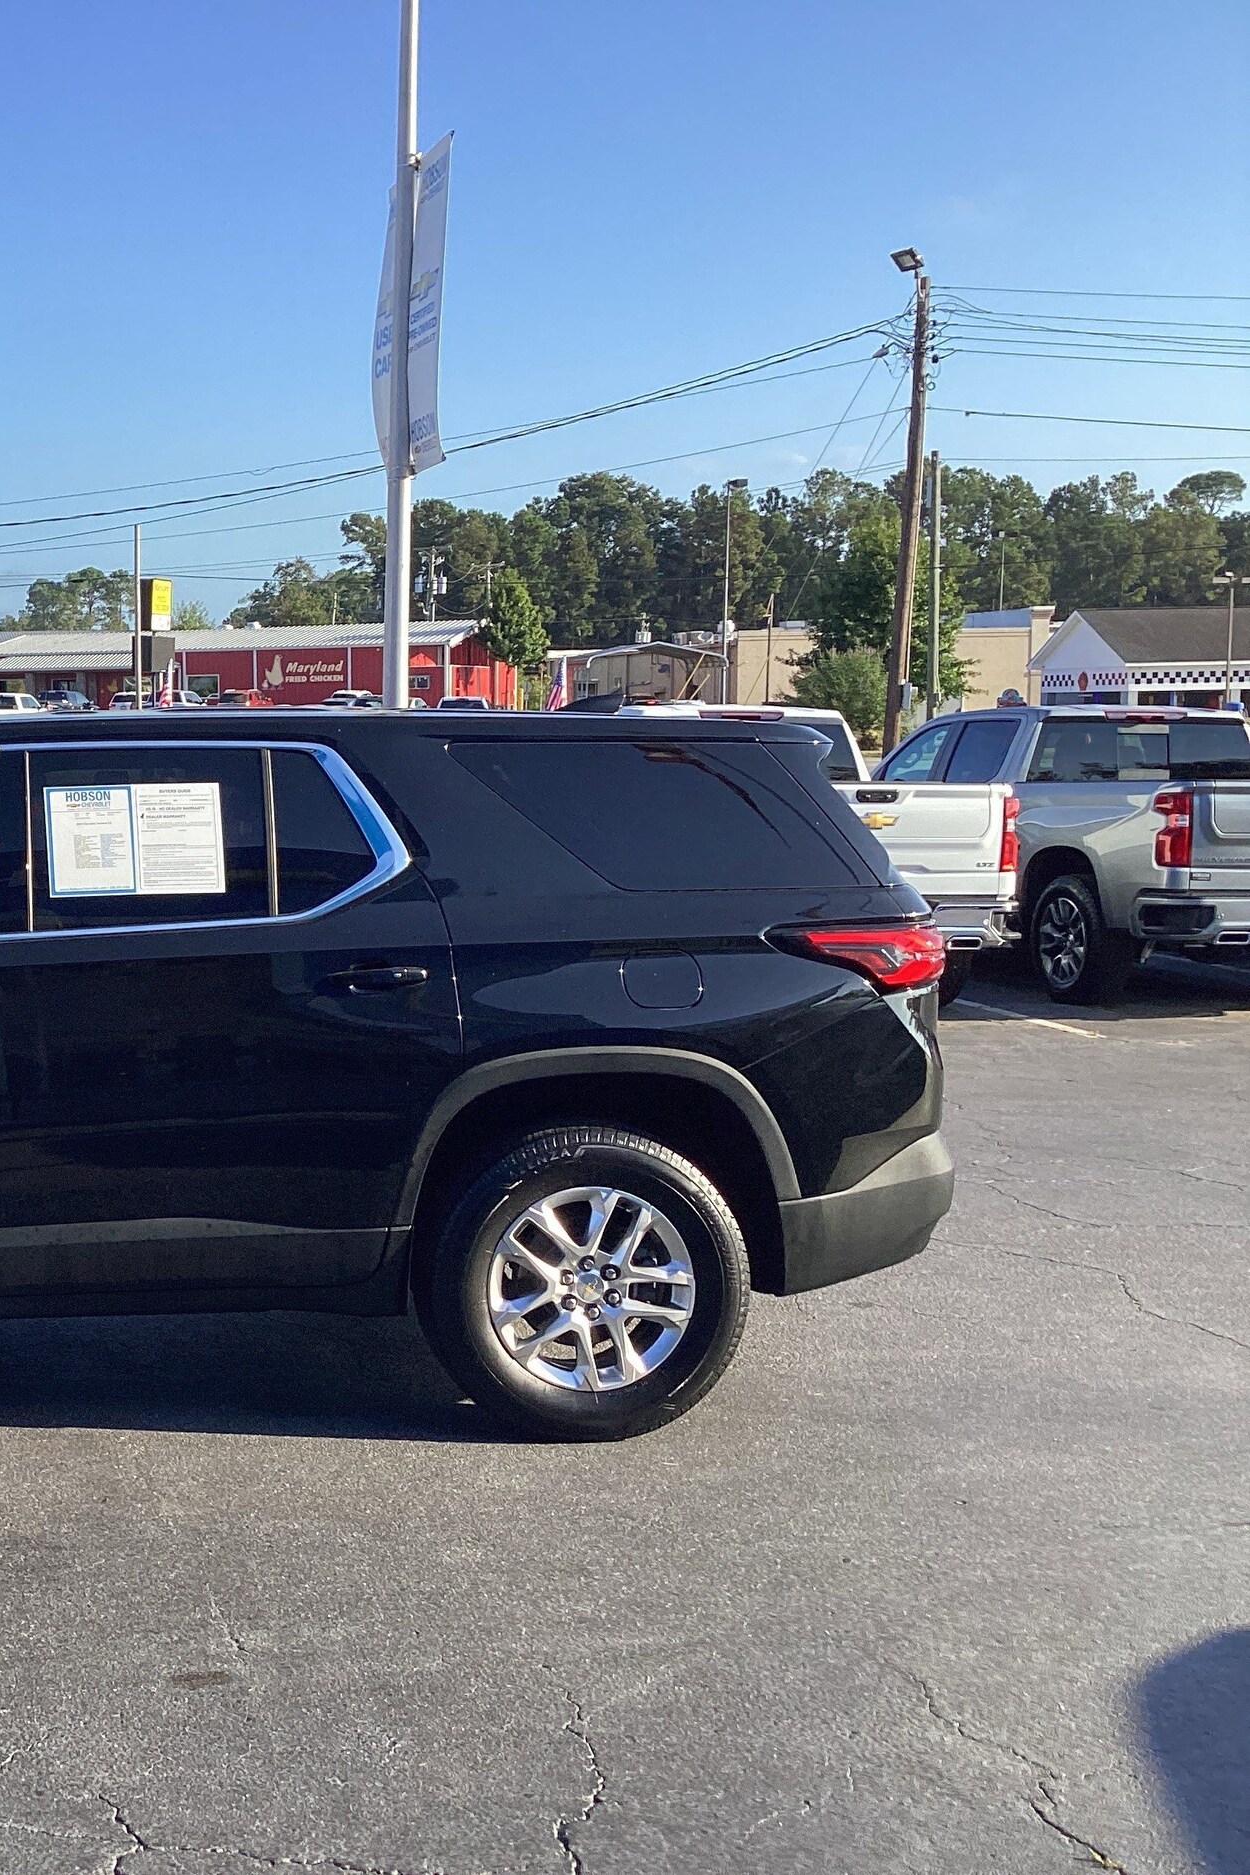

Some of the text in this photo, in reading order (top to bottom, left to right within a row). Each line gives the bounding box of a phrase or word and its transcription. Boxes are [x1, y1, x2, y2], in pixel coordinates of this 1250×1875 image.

[286, 660, 344, 675] Maryland
[285, 674, 344, 683] FRIED CHICKEN
[65, 791, 111, 803] HOBSON
